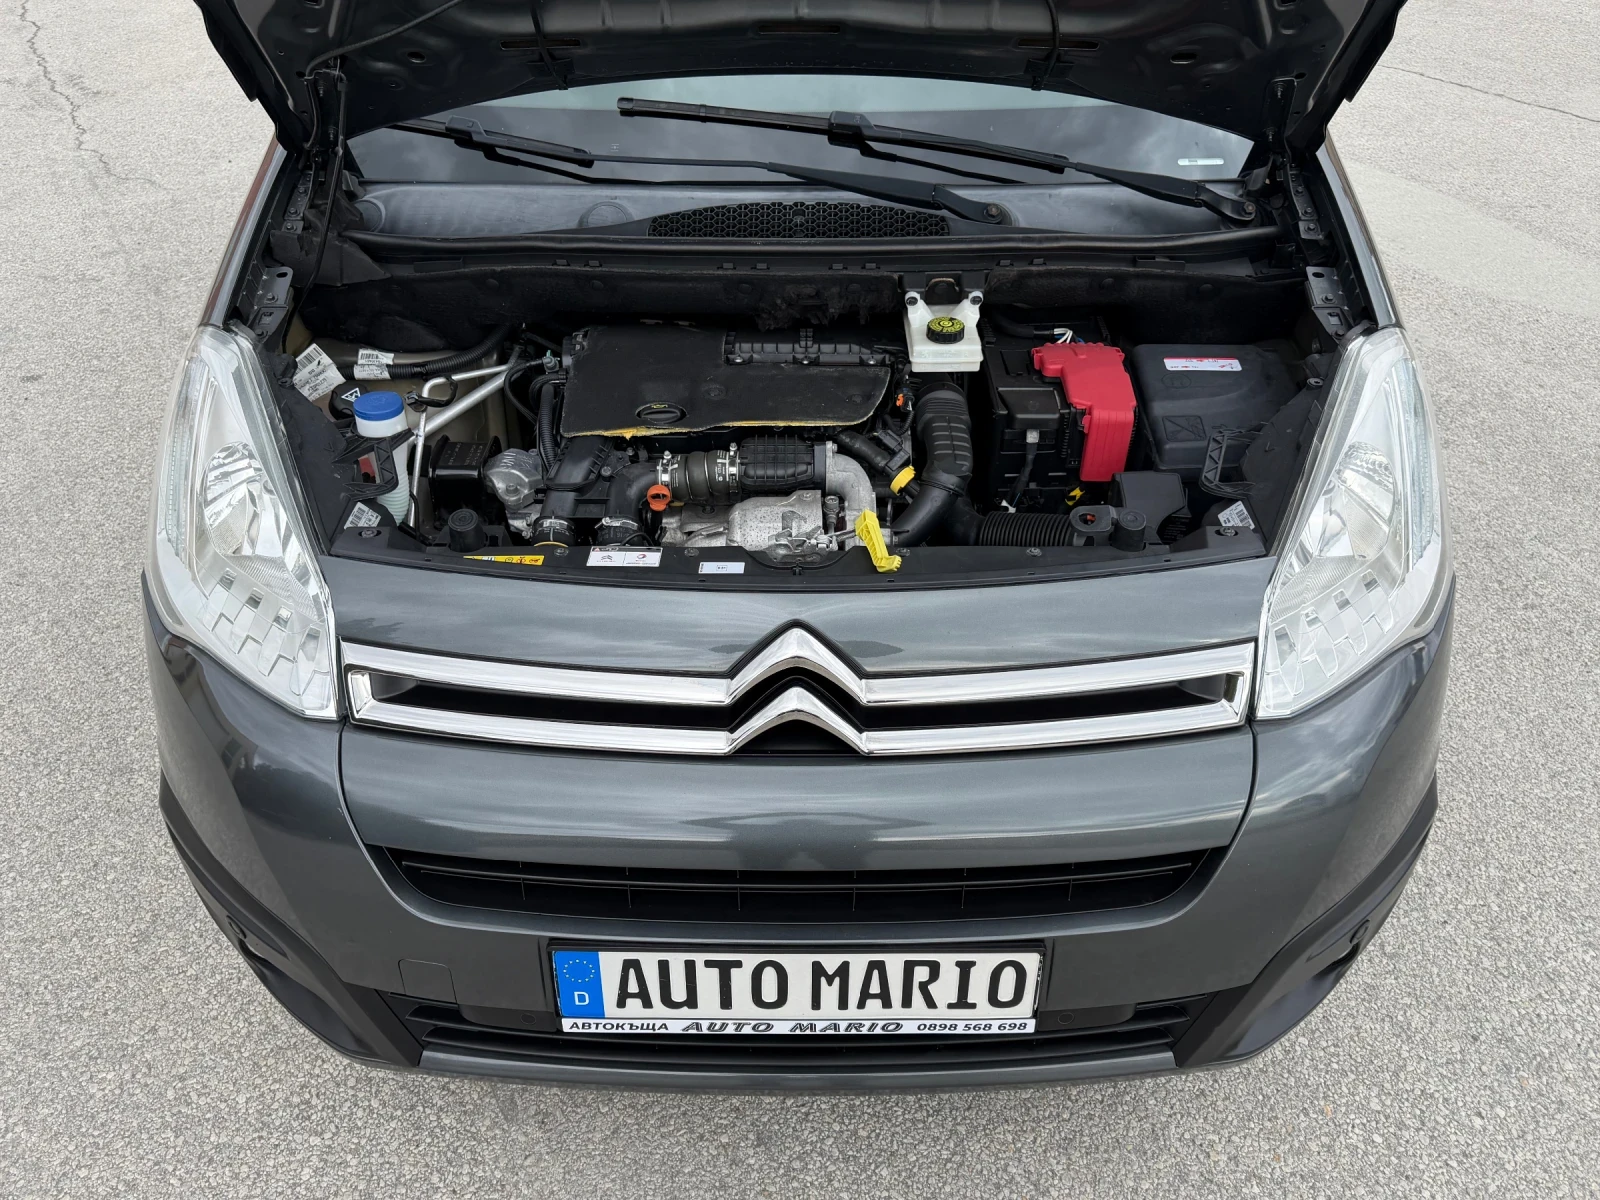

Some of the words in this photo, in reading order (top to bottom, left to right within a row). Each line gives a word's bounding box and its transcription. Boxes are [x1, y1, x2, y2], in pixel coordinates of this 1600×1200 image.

[616, 958, 789, 1011] AUTO
[811, 960, 1028, 1010] MARIO
[574, 991, 589, 1005] D
[569, 1021, 669, 1032] АВТОКЪЩА
[681, 1021, 774, 1033] AUTO
[788, 1022, 904, 1033] MARIO
[917, 1022, 958, 1031] 0898
[963, 1023, 993, 1031] 568
[997, 1022, 1028, 1031] 698
